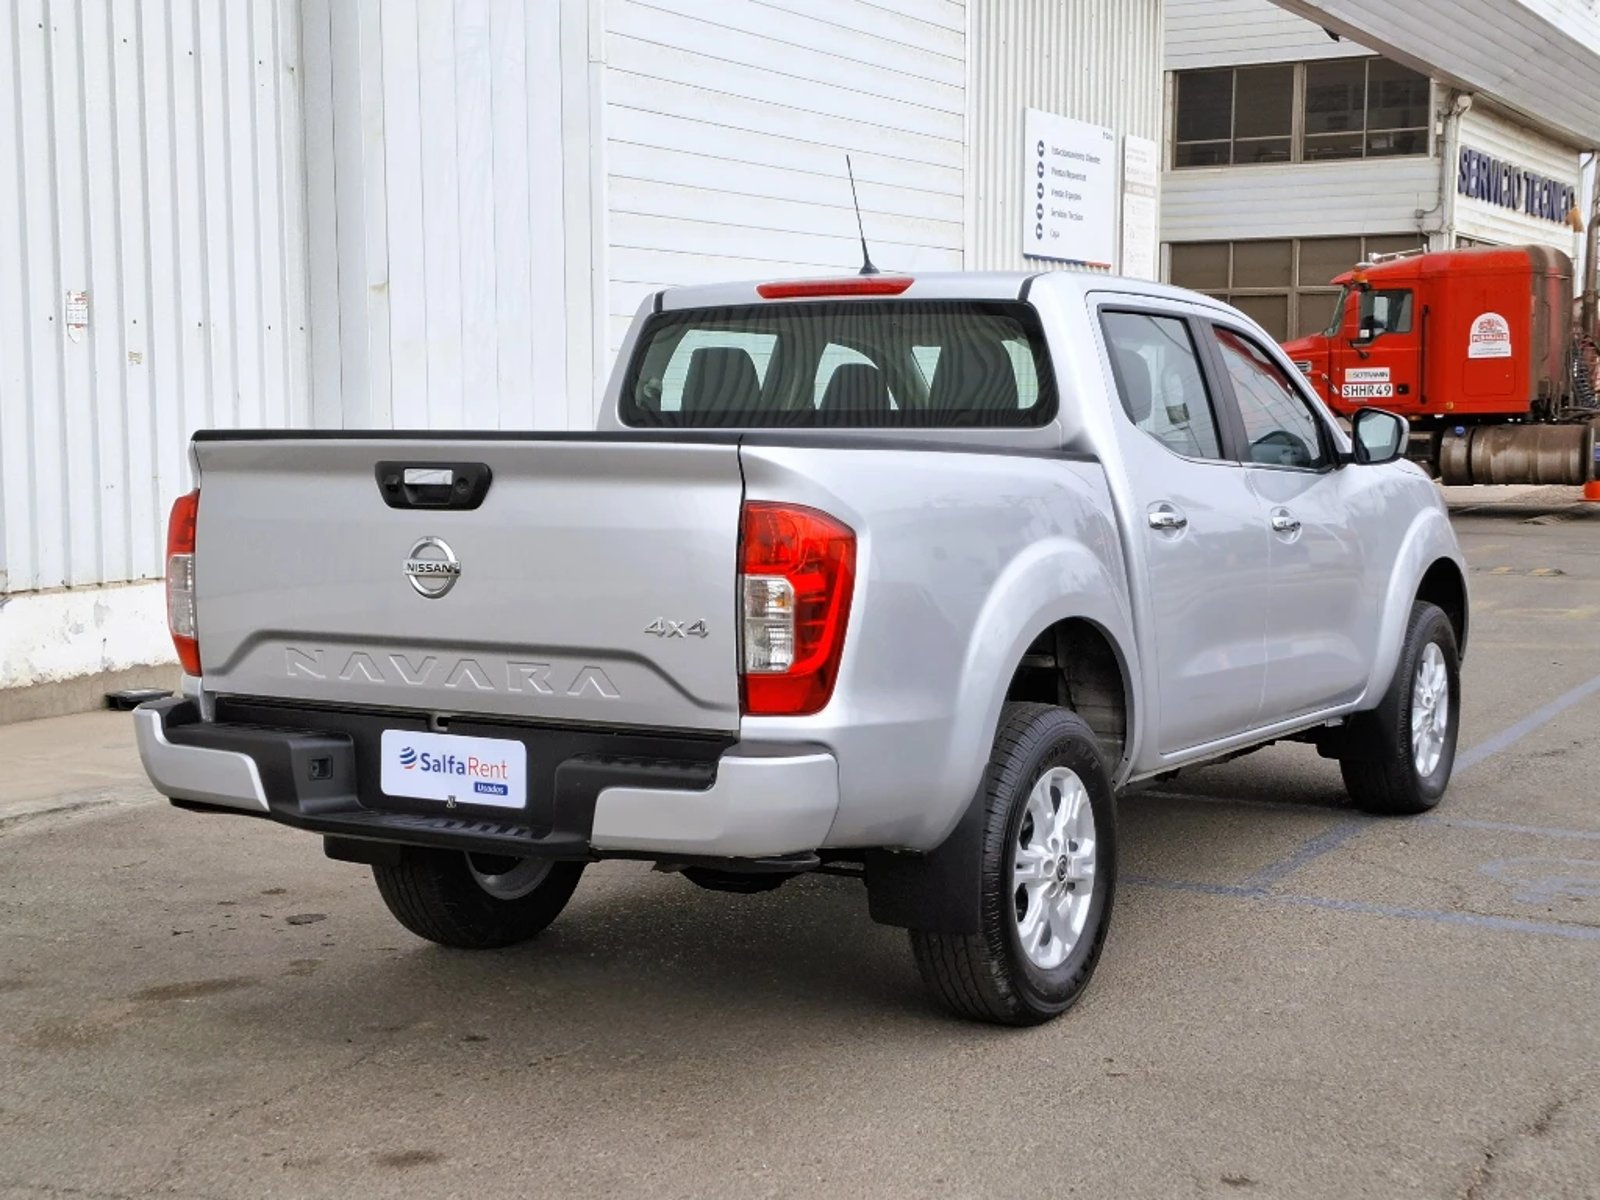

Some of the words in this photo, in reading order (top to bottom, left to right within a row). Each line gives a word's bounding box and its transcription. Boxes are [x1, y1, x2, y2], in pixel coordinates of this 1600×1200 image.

[1458, 145, 1522, 210] SERVICIO
[407, 562, 452, 574] NISSAN
[285, 647, 620, 698] NAVARA
[420, 752, 509, 780] SalfaRent
[477, 783, 504, 795] Usados
